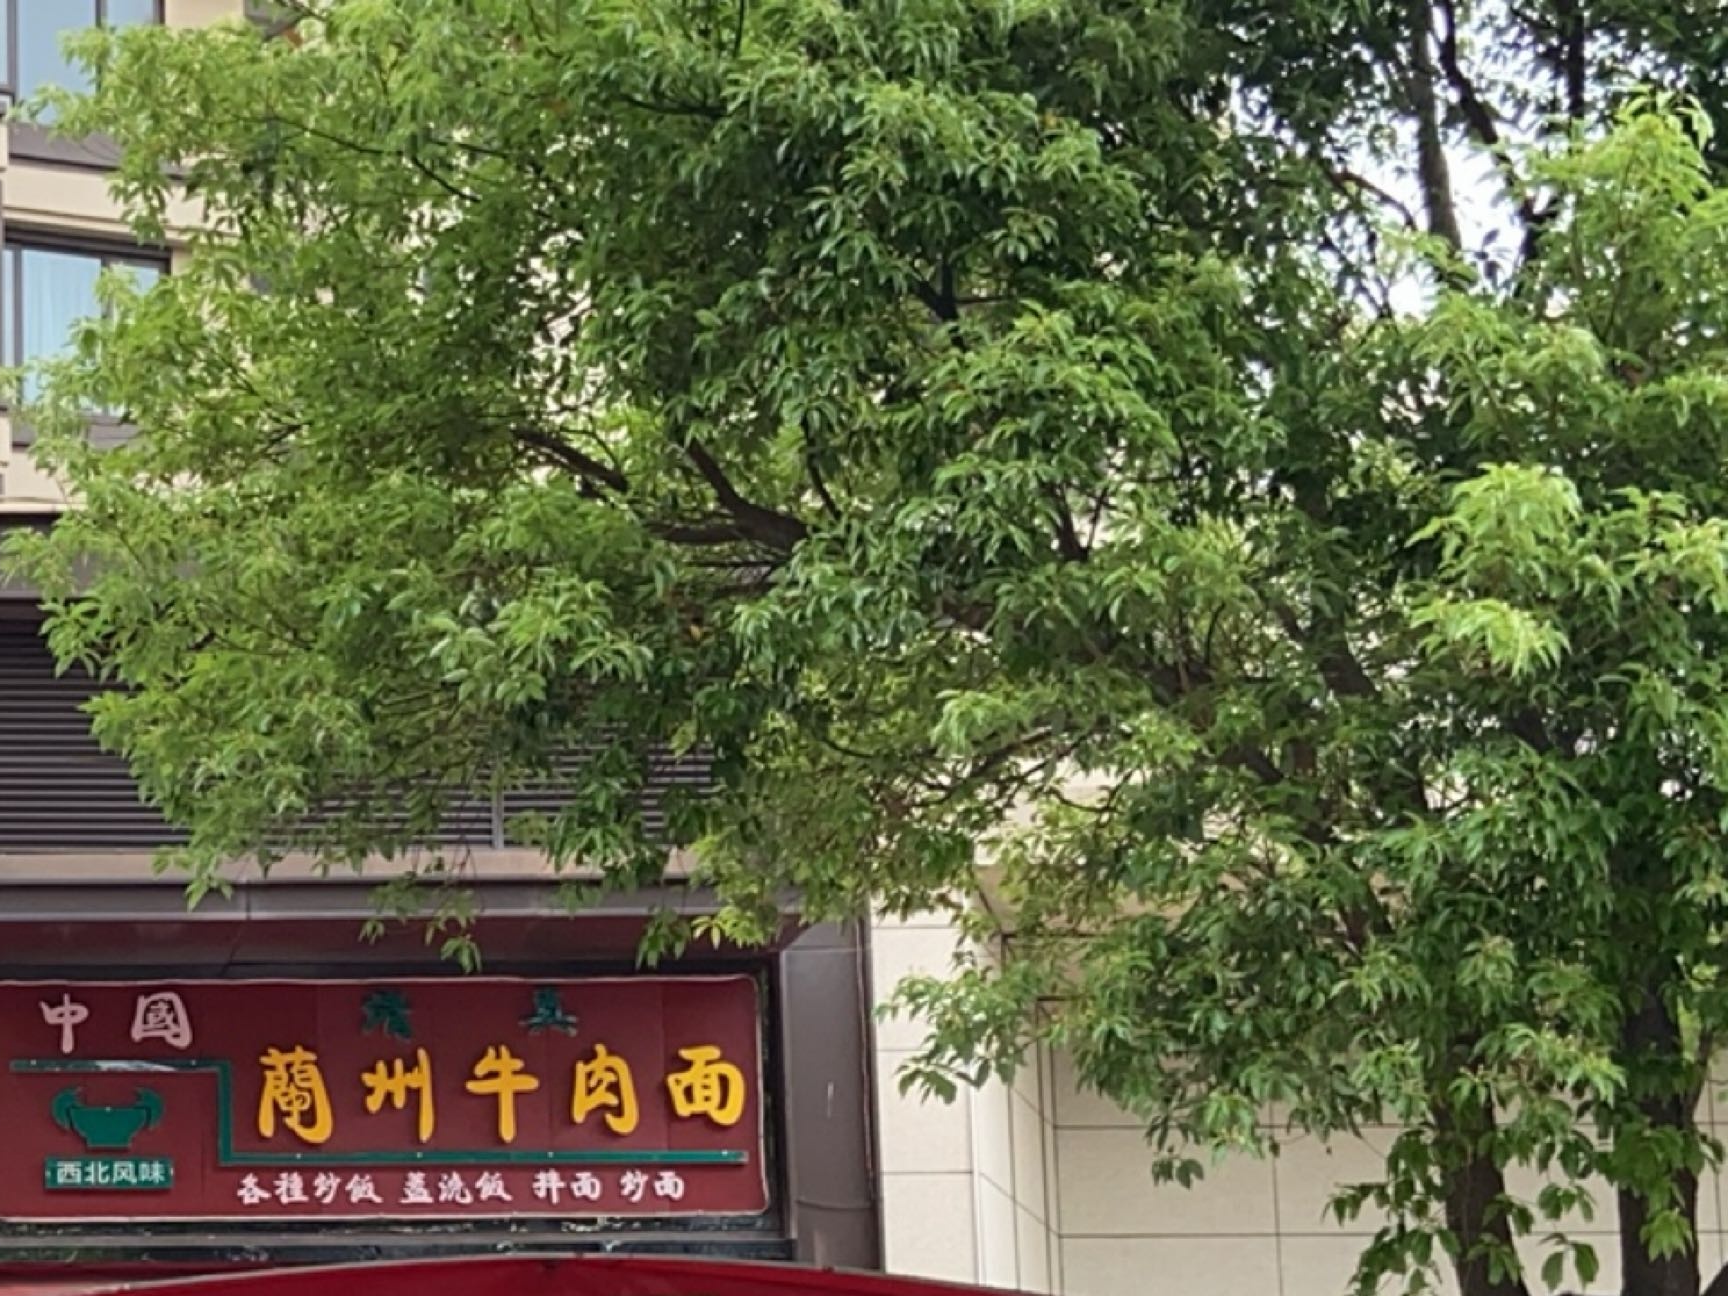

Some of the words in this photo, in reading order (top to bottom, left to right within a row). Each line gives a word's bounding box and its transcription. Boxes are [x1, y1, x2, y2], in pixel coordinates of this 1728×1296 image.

[39, 991, 193, 1054] 中國
[258, 1043, 746, 1144] 蘭州牛肉面
[56, 1160, 165, 1186] 西北风味
